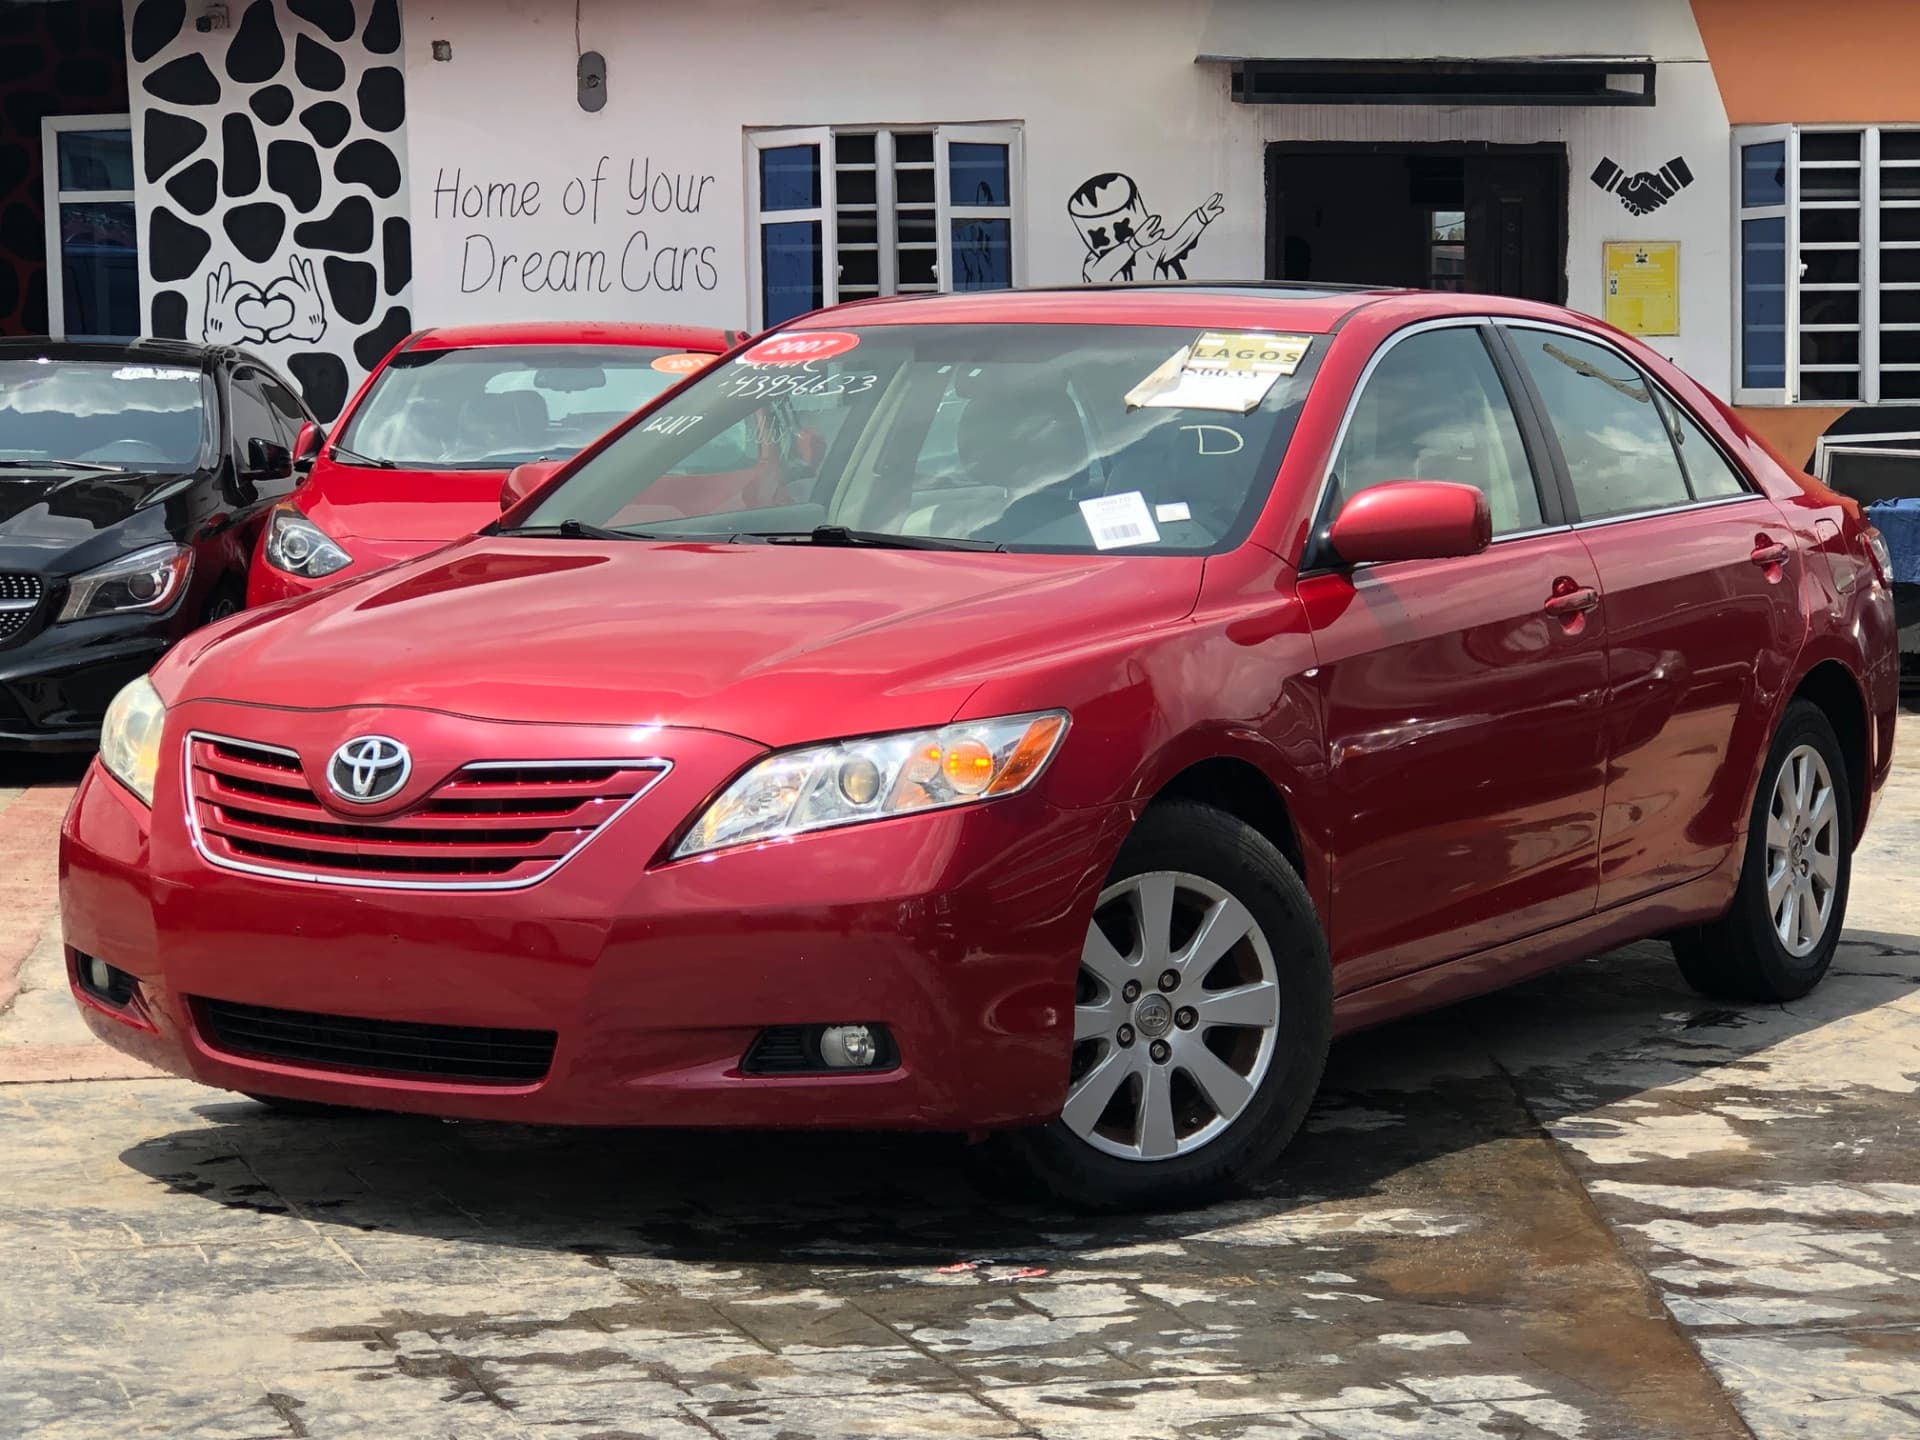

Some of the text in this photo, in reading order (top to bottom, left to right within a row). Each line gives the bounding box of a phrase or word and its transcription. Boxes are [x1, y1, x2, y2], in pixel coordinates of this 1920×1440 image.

[433, 155, 715, 224] Home of Your
[460, 230, 718, 293] Dream Cars
[763, 339, 841, 355] 2007
[1194, 347, 1300, 363] LAGOS
[1179, 424, 1244, 455] D
